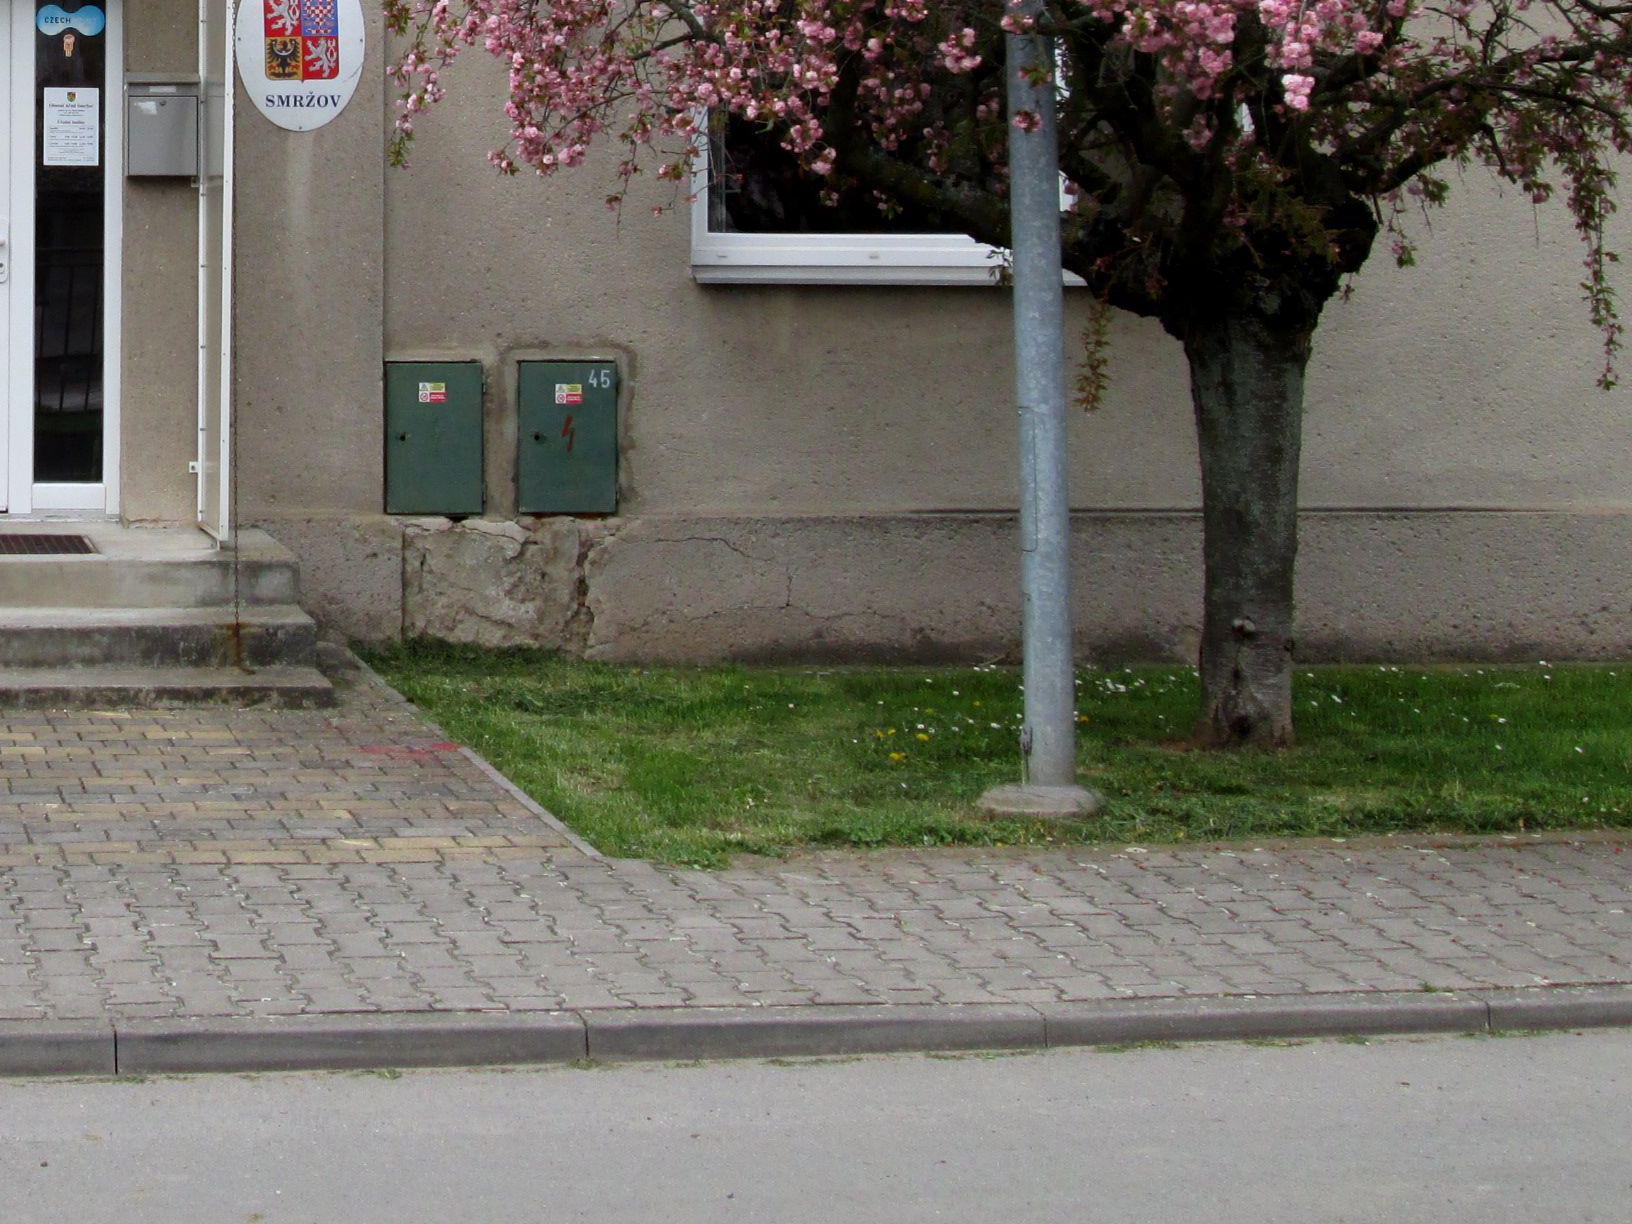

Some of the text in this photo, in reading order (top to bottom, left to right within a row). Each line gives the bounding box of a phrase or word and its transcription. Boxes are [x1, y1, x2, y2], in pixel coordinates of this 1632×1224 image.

[44, 16, 71, 24] CZECH
[265, 91, 341, 108] SMRŽOV
[588, 369, 610, 388] 45
